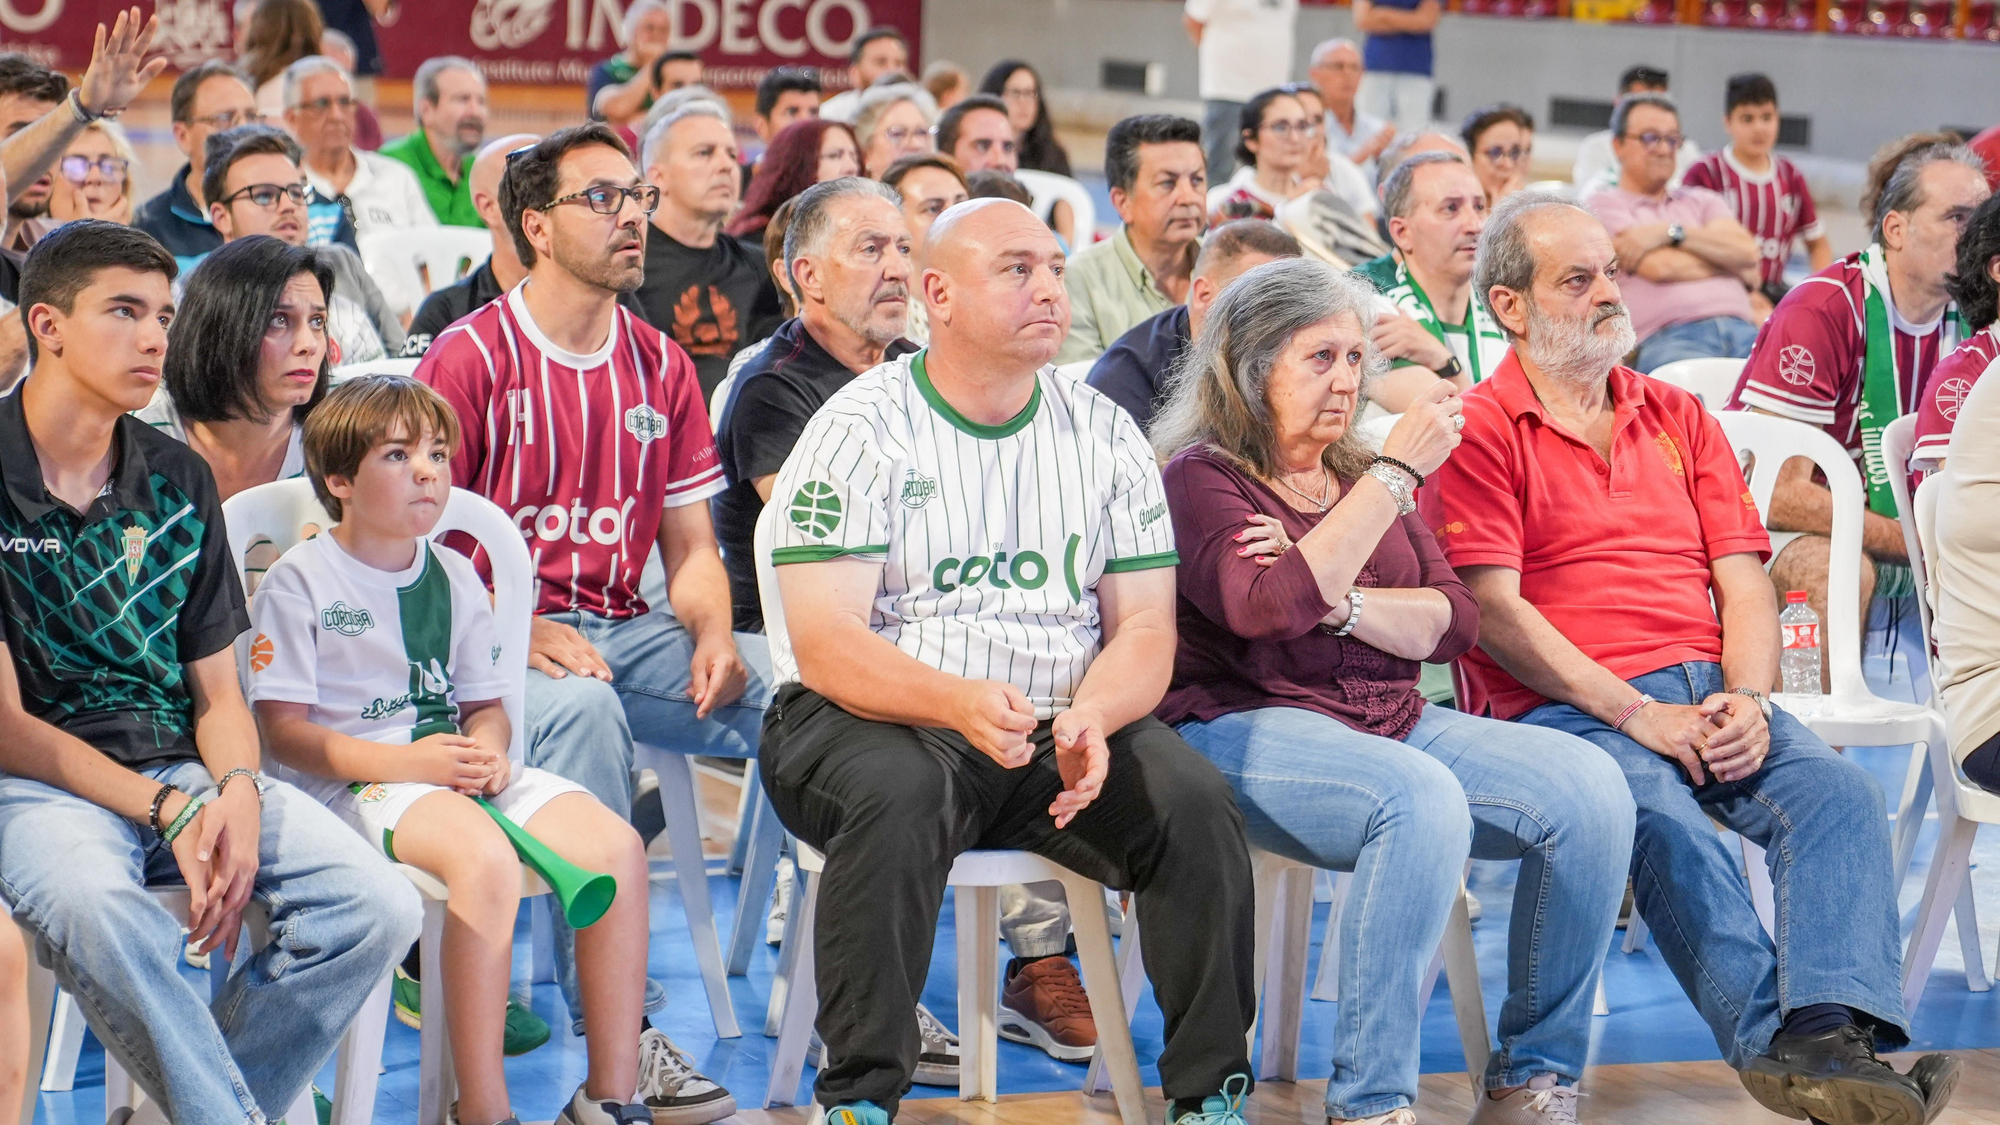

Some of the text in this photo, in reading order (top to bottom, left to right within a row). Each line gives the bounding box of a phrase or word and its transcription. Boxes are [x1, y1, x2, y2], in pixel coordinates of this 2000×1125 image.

[511, 497, 621, 545] coto
[0, 537, 60, 553] VOVA
[933, 550, 1049, 593] coto
